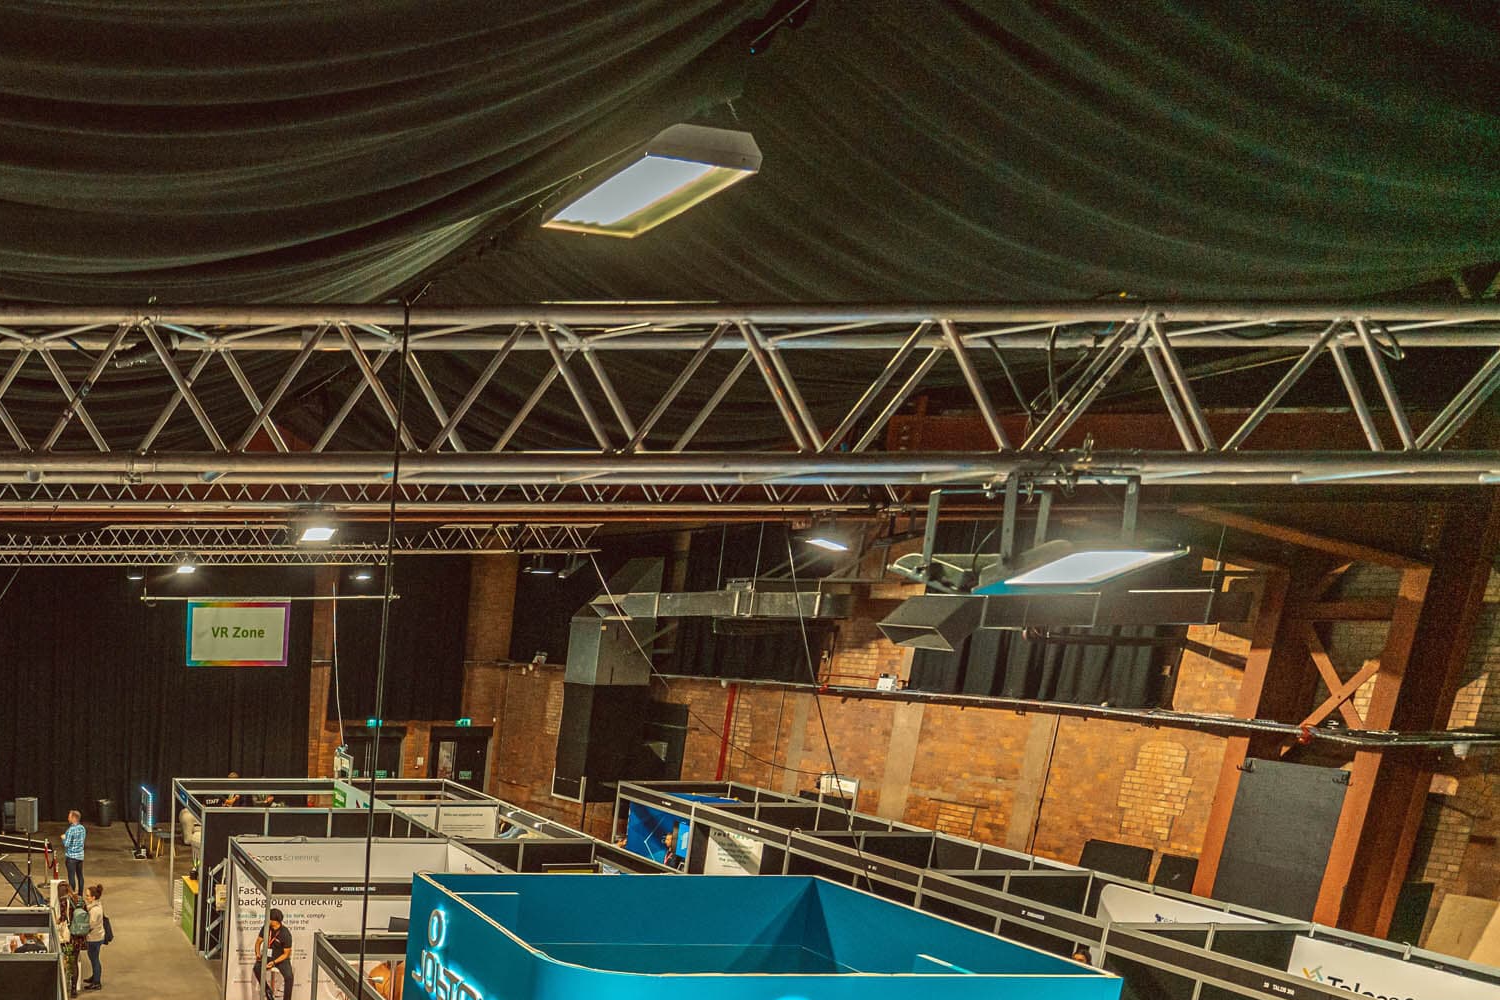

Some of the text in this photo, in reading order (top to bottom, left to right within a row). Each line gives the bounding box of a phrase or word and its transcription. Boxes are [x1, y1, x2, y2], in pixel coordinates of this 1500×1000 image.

[211, 626, 265, 639] VR Zone
[238, 886, 261, 896] Fast,
[237, 898, 297, 908] backgound
